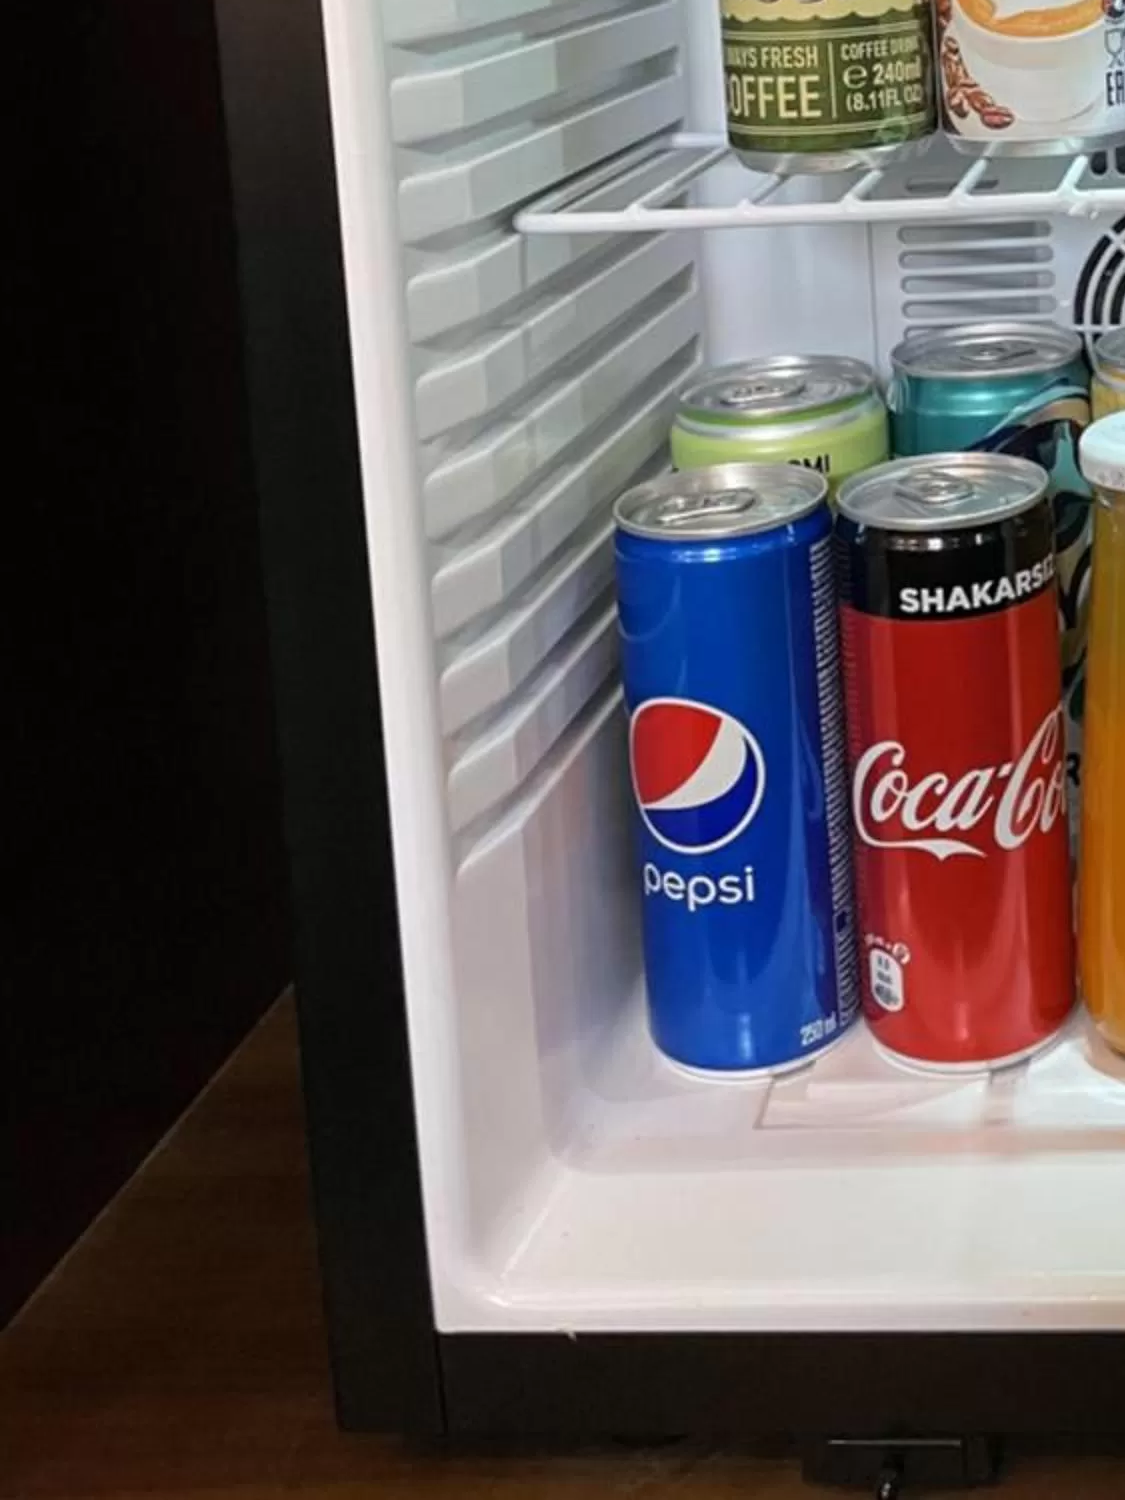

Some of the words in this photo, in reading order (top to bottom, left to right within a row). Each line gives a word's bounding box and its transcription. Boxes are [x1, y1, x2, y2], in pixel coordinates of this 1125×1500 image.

[761, 45, 819, 69] FRESH
[840, 41, 888, 61] COFFEE
[729, 74, 823, 120] OFFEE
[643, 862, 755, 912] pepsi
[799, 1019, 823, 1047] 250
